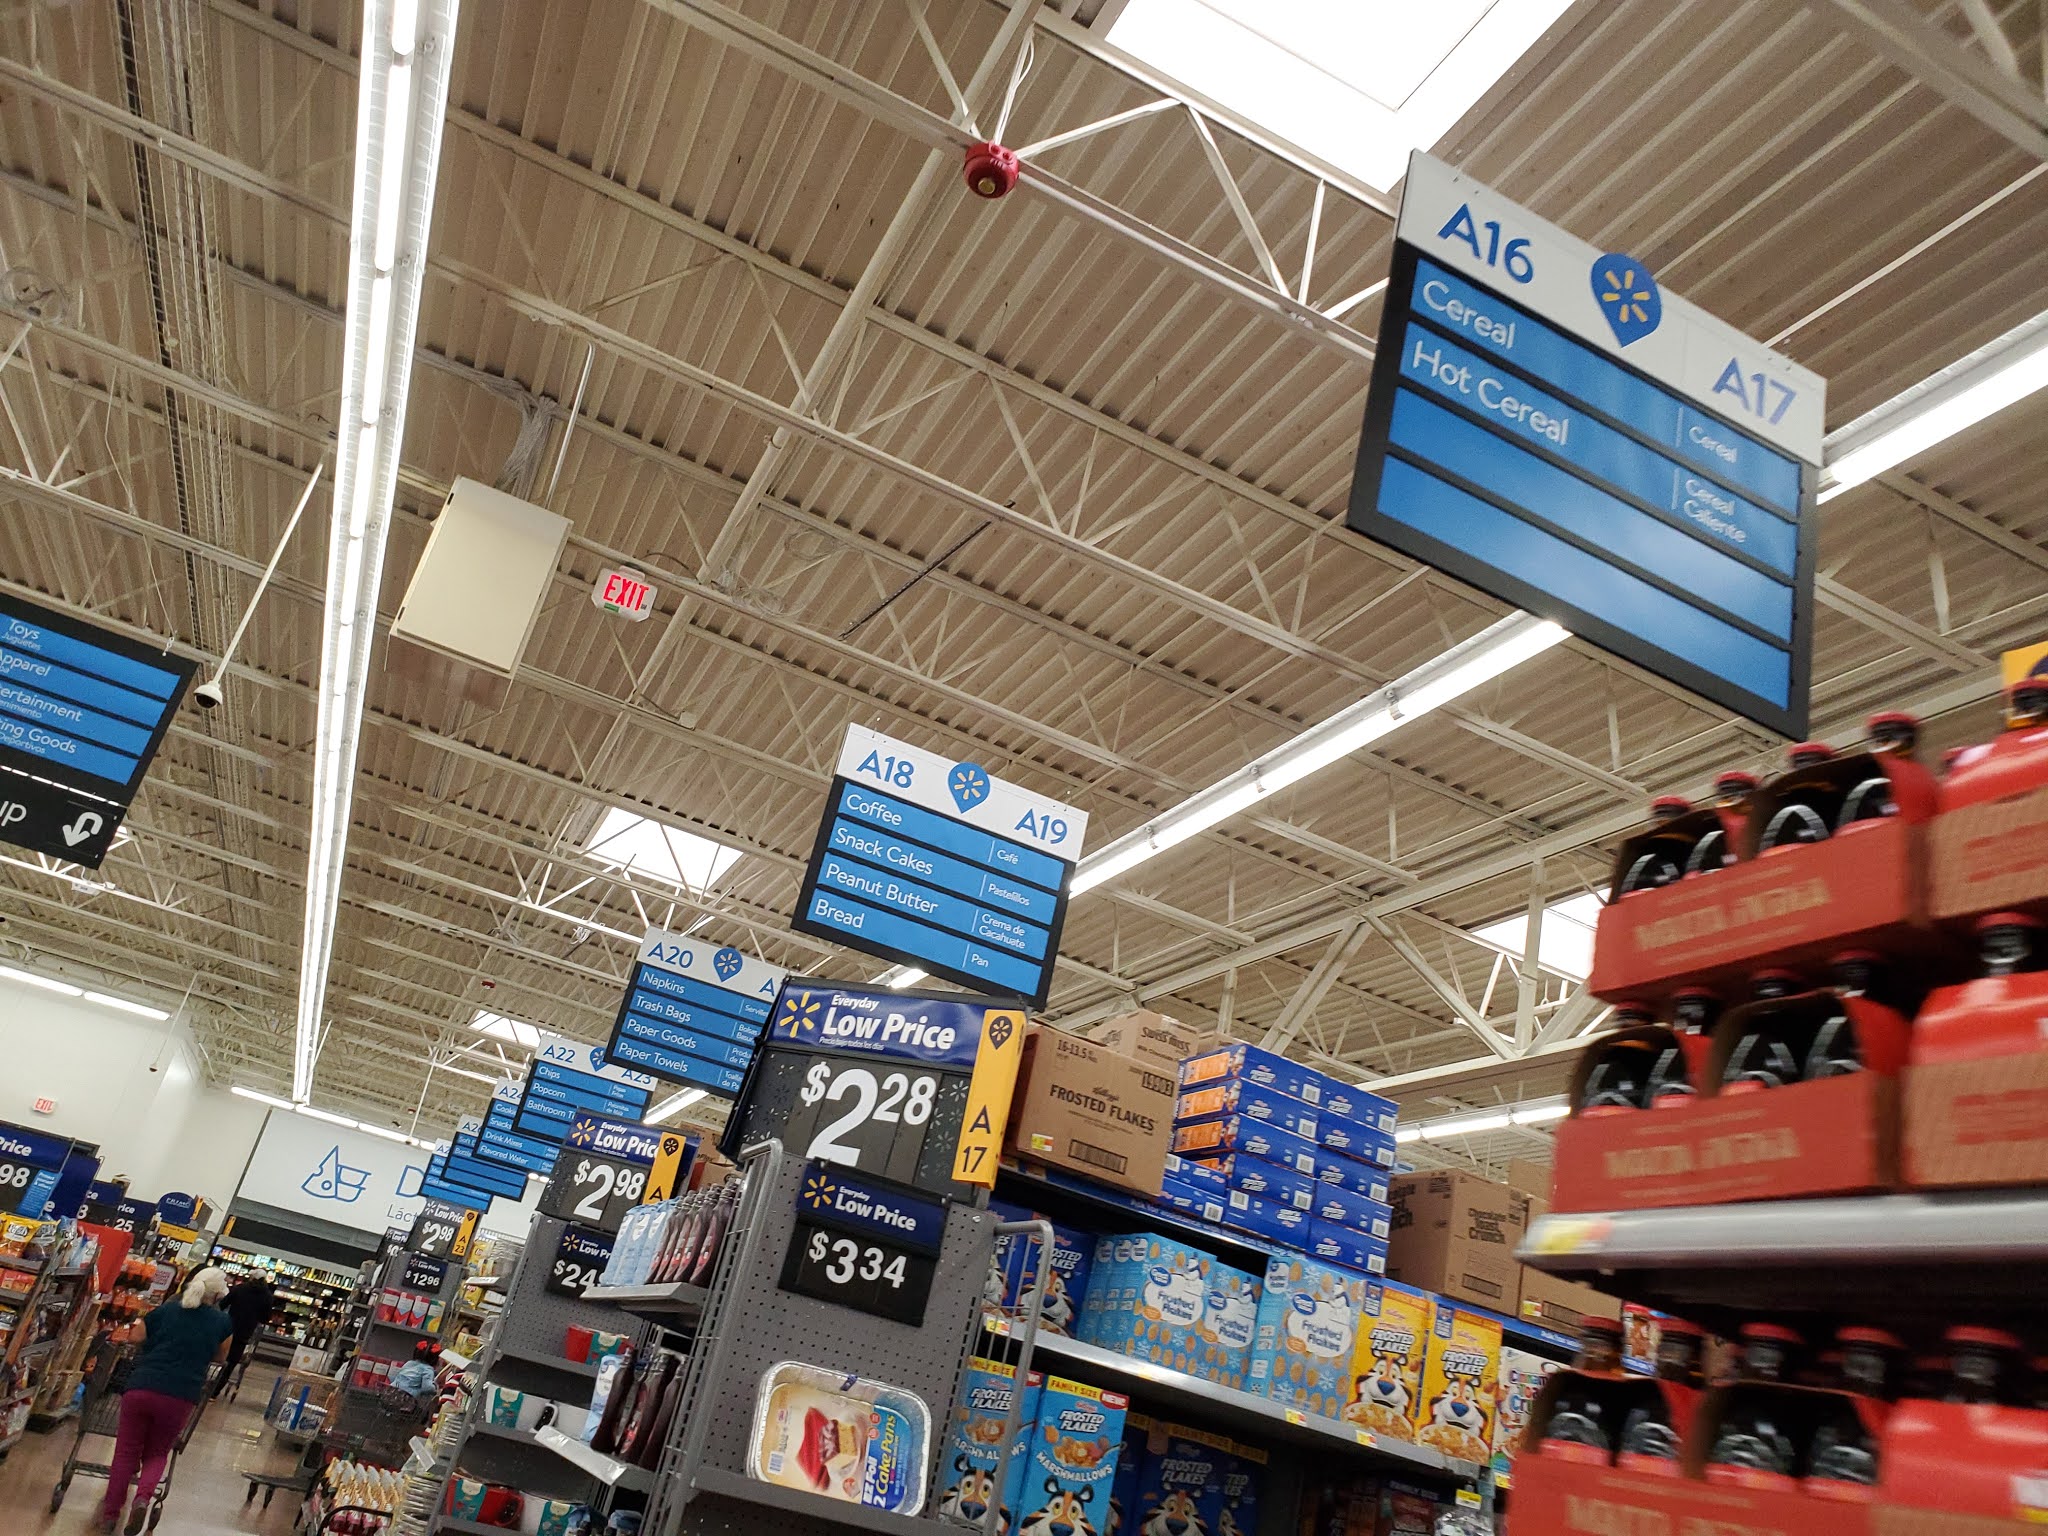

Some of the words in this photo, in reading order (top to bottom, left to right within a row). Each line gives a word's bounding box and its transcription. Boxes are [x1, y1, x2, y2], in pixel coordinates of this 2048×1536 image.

[1437, 204, 1534, 284] A16
[1422, 280, 1516, 350] Cereal
[1412, 341, 1472, 396] Hot
[1478, 377, 1568, 447] Cereal
[1713, 357, 1797, 426] A17
[1689, 426, 1738, 463] Cereal
[1685, 479, 1735, 516] Cereal
[1683, 499, 1747, 542] Caliente
[603, 574, 650, 611] EXIT
[8, 619, 40, 639] Toys
[0, 686, 82, 721] ertainment
[28, 728, 77, 754] Goods
[856, 749, 915, 789] A18
[846, 794, 902, 826] Coffee
[1014, 808, 1068, 844] A19
[835, 827, 882, 858] Snack
[886, 846, 933, 875] Cakes
[996, 849, 1019, 865] Café
[826, 863, 882, 896] Peanut
[886, 884, 939, 914] Butter
[988, 884, 1030, 906] Pastelillos
[814, 899, 865, 928] Bread
[981, 913, 1011, 933] Crema
[1012, 922, 1025, 936] de
[979, 926, 1026, 950] Cacahuate
[647, 942, 694, 969] A20
[970, 953, 989, 968] Pan
[642, 971, 686, 994] Napkins
[636, 995, 663, 1014] Trash
[665, 1004, 691, 1023] Bags
[831, 995, 879, 1011] Everyday
[627, 1019, 659, 1038] Paper
[661, 1030, 697, 1050] Goods
[822, 1007, 882, 1039] Low
[880, 1013, 956, 1050] Price
[543, 1044, 576, 1064] A22
[619, 1042, 651, 1062] Paper
[653, 1052, 689, 1073] Towels
[538, 1065, 561, 1080] Chips
[532, 1082, 567, 1099] Popcorn
[527, 1099, 567, 1119] Bathroom
[1050, 1084, 1106, 1113] FROSTED
[1109, 1105, 1155, 1131] FLAKES
[601, 1121, 627, 1134] Everyday
[968, 1105, 991, 1134] A
[485, 1131, 503, 1143] Drink
[594, 1129, 626, 1152] Low
[626, 1135, 660, 1158] Pric
[480, 1145, 508, 1160] Flavored
[508, 1152, 529, 1165] Water
[962, 1146, 987, 1173] 17
[649, 1186, 663, 1201] A
[839, 1186, 870, 1201] Everyday
[434, 1208, 449, 1219] Low
[835, 1193, 872, 1220] Low
[874, 1206, 917, 1232] Price
[454, 1244, 464, 1254] 23
[579, 1243, 600, 1256] Low
[1370, 1328, 1416, 1345] FROSTED
[1371, 1340, 1411, 1354] FLAKES
[1441, 1350, 1489, 1367] FROSTED
[1444, 1361, 1484, 1376] FLAKES
[970, 1388, 1012, 1400] FROSTE
[1050, 1379, 1078, 1393] FAMILY
[1080, 1387, 1098, 1399] SIZE
[1101, 1393, 1127, 1406] NEW!
[1059, 1410, 1105, 1424] FROSTED
[1060, 1420, 1101, 1433] FLAKES
[881, 1415, 896, 1453] Pans
[876, 1453, 892, 1494] Cake
[1035, 1451, 1113, 1482] MARSHMALLOWS
[1160, 1459, 1213, 1473] FROSTED
[1162, 1471, 1207, 1485] FLAKES
[873, 1495, 887, 1508] 2
